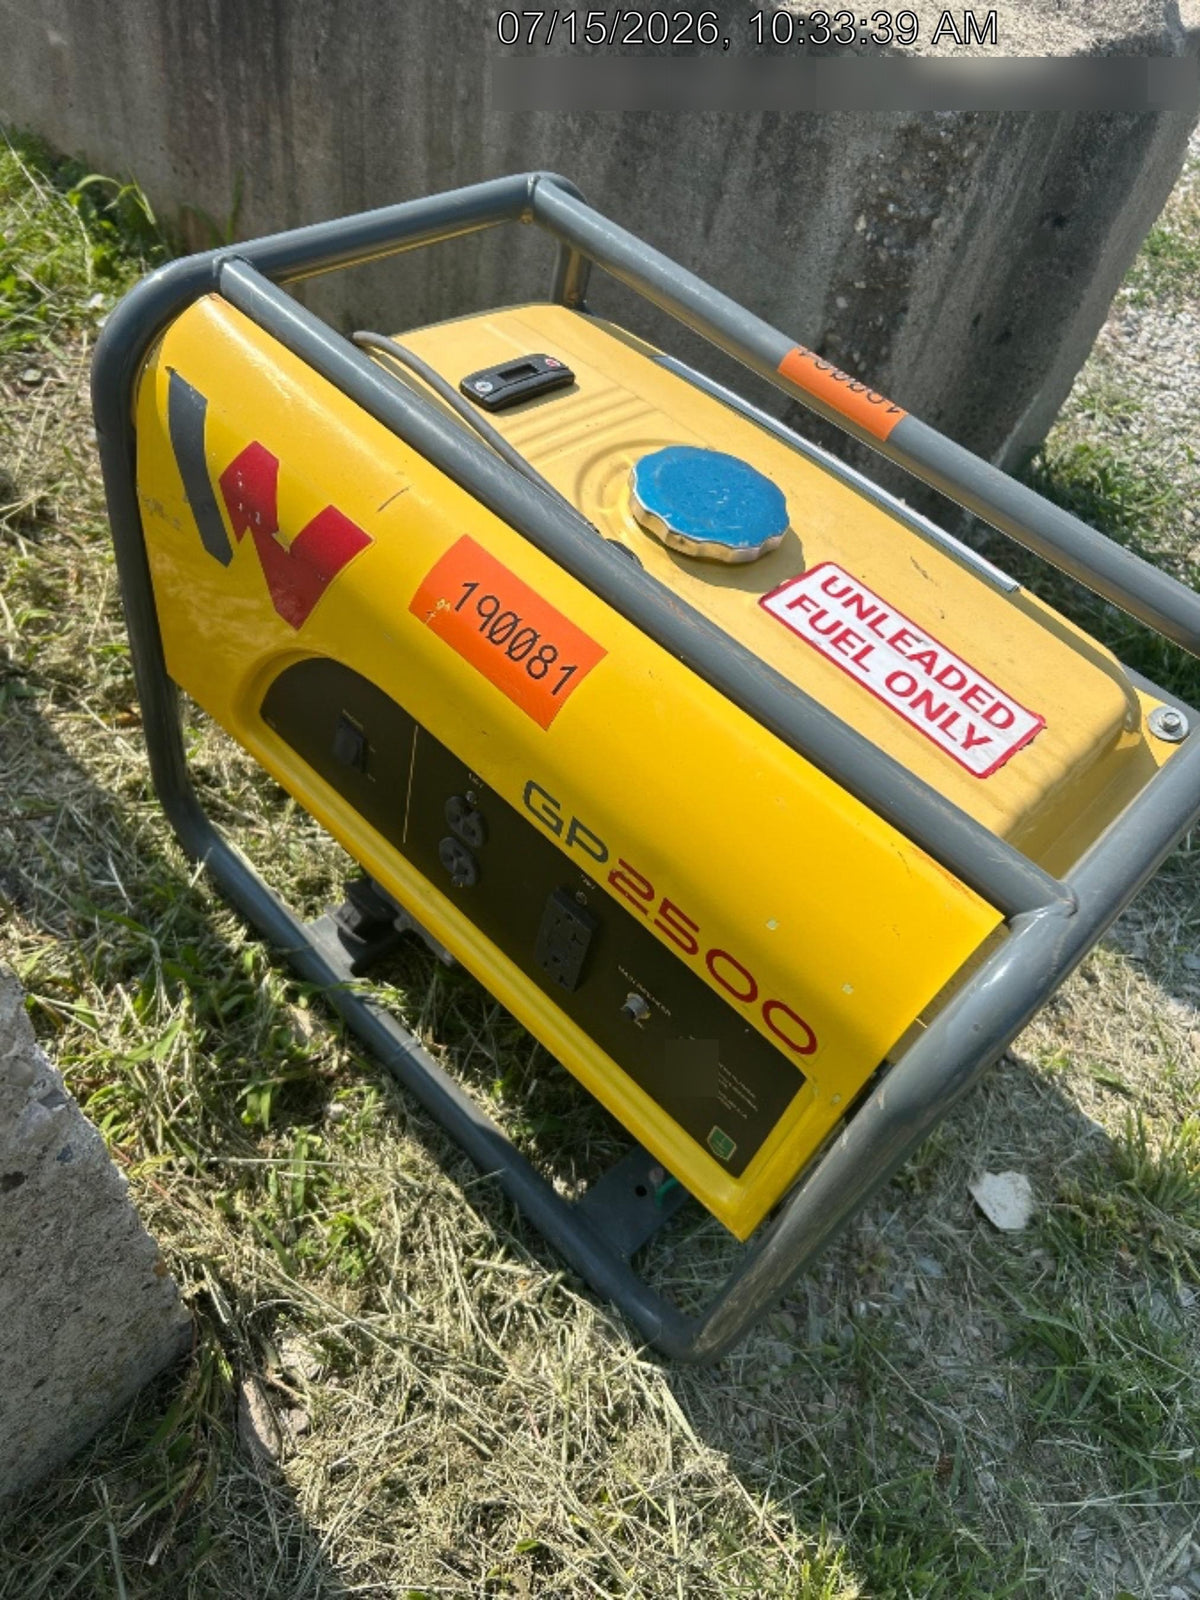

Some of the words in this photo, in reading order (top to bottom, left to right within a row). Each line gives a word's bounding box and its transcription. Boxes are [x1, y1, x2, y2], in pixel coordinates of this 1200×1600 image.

[786, 593, 876, 673] FUEL
[884, 670, 993, 751] ONLY
[820, 575, 1015, 730] UNLEADED
[523, 780, 818, 1055] GP2500
